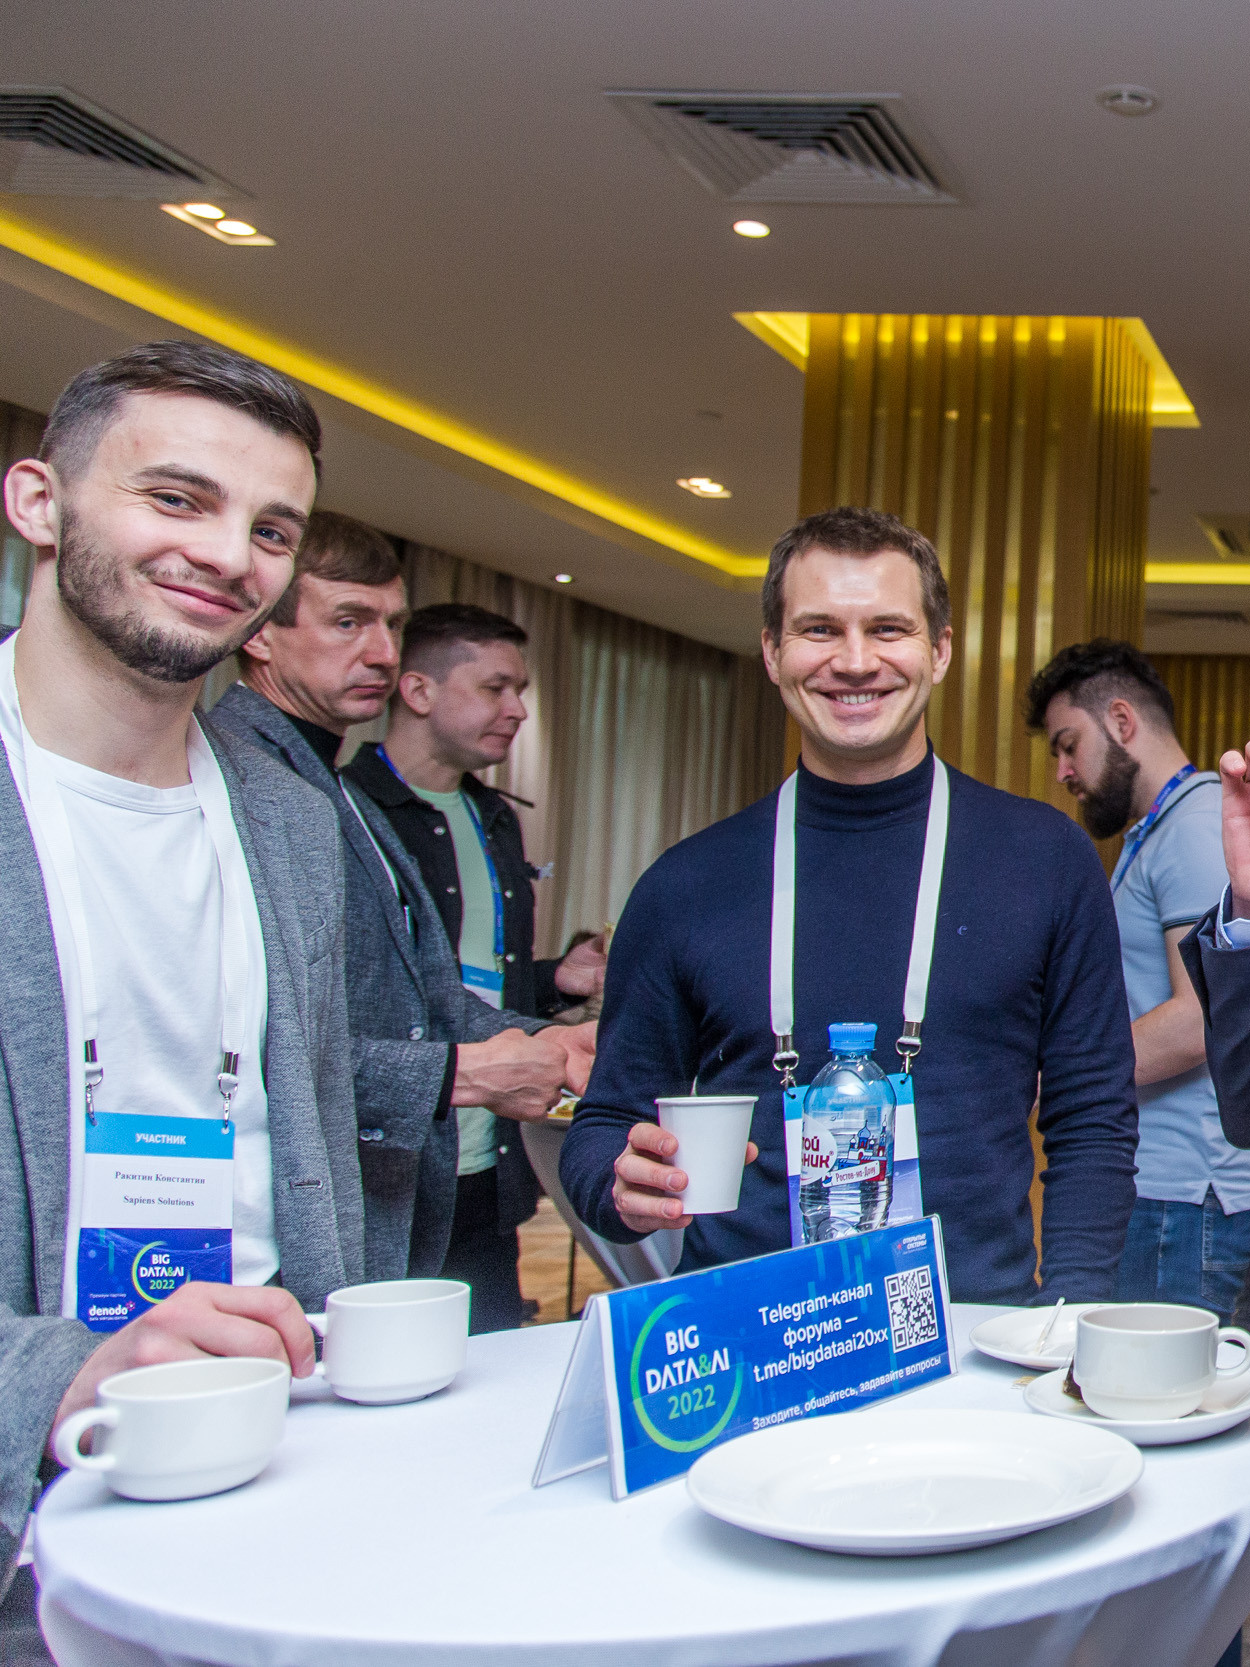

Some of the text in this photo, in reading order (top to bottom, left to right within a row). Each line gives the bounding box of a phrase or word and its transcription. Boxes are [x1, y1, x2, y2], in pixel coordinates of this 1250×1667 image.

[135, 1132, 186, 1146] УЧАСТНИК
[115, 1171, 206, 1185] Ракитин Константин
[123, 1195, 195, 1207] Sapiens Solutions
[151, 1253, 170, 1265] BIG
[139, 1266, 184, 1278] DATA&AI
[149, 1279, 175, 1290] 2022
[89, 1304, 128, 1316] denodo
[758, 1282, 873, 1327] Telegram-канал
[665, 1325, 699, 1356] BIG
[783, 1317, 842, 1350] форума
[753, 1327, 889, 1383] t.me/bigdataai20xx
[645, 1347, 730, 1394] DATA&AI
[667, 1384, 716, 1421] 2022
[752, 1356, 942, 1431] Заходите, общайтесь, задавайте вопросы
